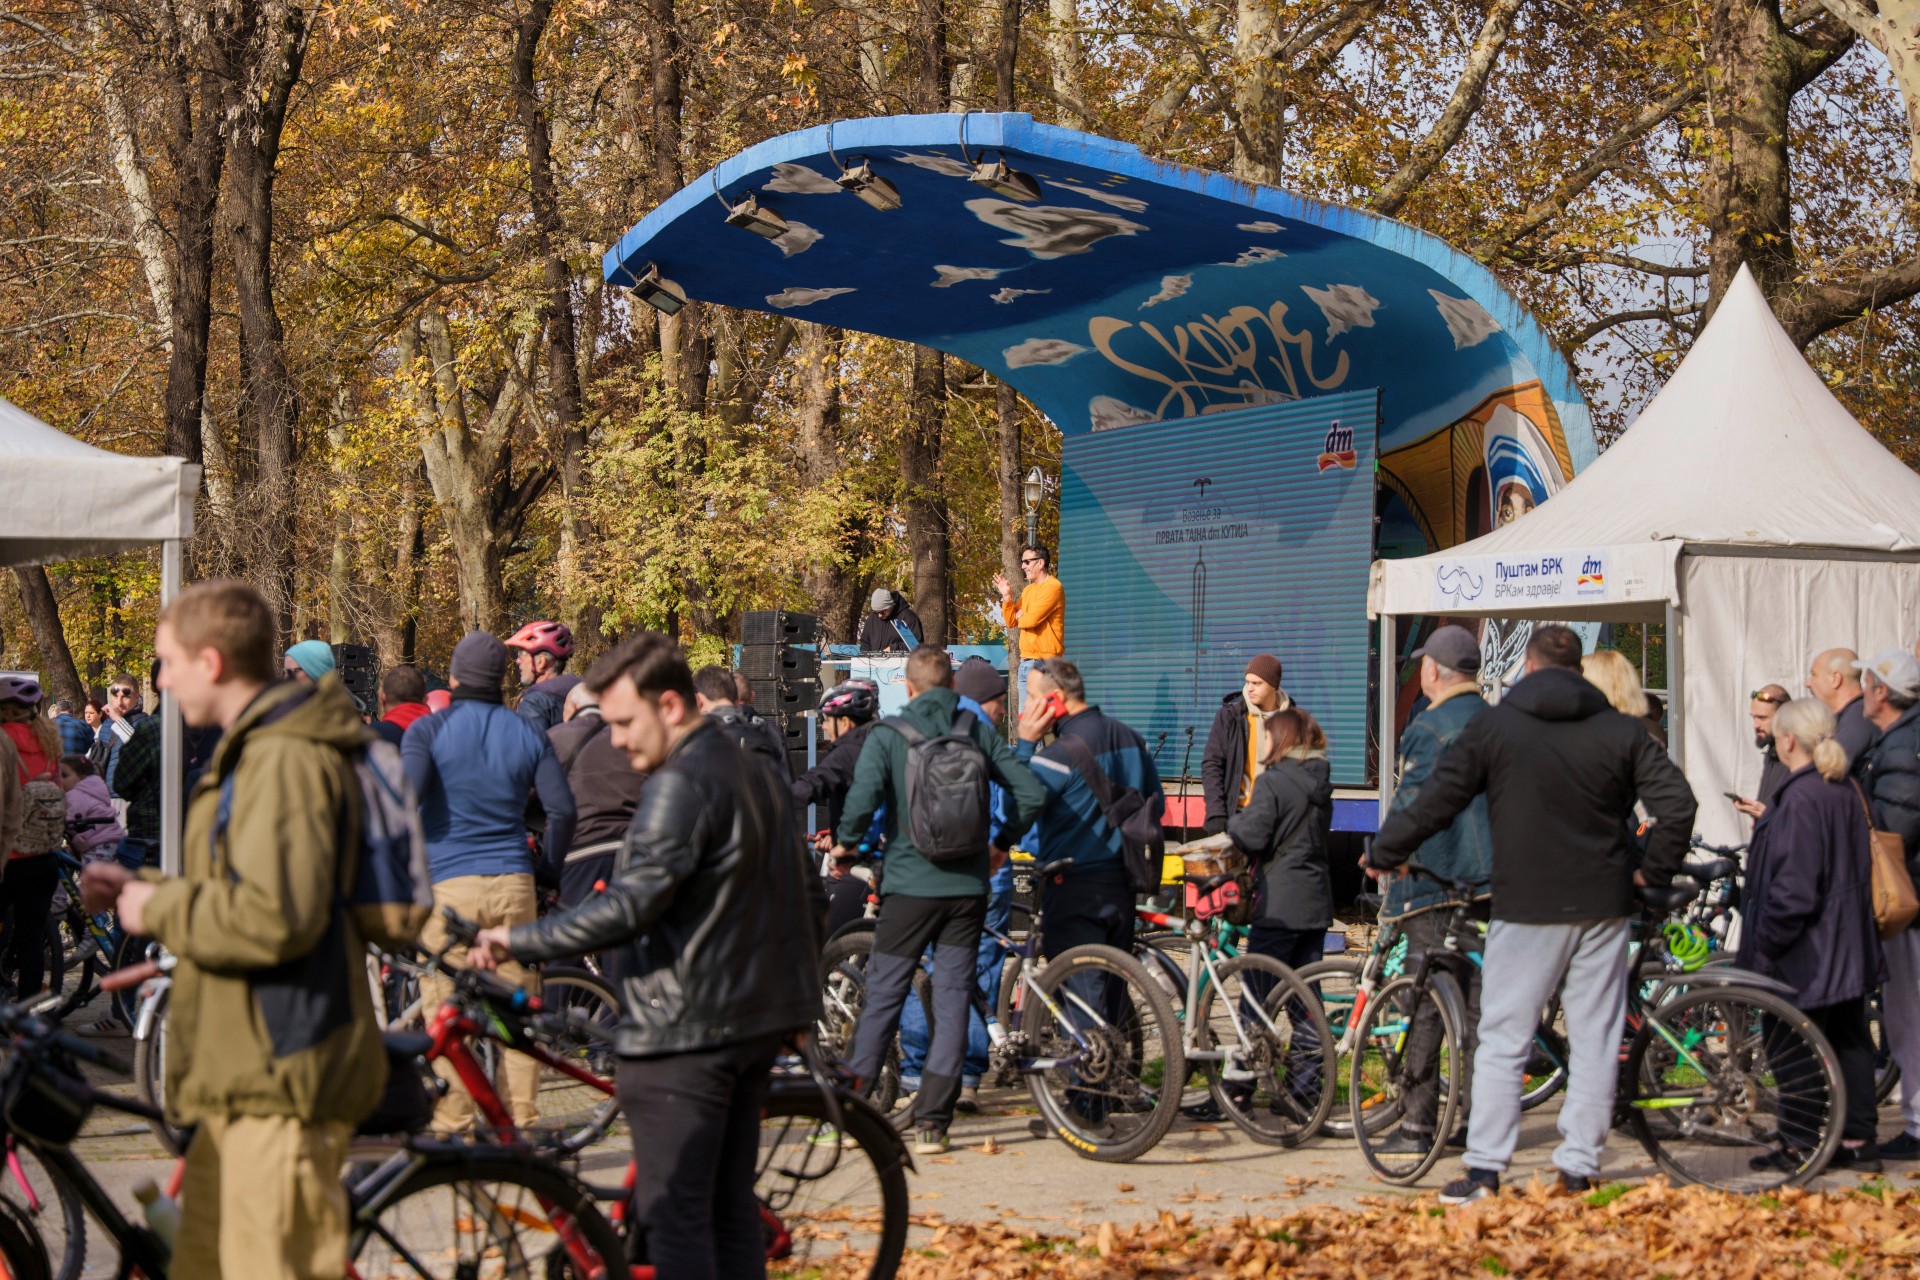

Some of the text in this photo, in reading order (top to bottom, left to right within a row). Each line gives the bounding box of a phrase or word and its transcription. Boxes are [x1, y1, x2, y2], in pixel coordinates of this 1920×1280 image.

[1325, 422, 1352, 453] dm
[1213, 508, 1222, 520] за
[1156, 523, 1249, 544] ПРВАТА ТАЈНА dm КУТИЈА
[1495, 557, 1563, 582] Пуштам БРК
[1582, 555, 1602, 574] dm
[1495, 581, 1562, 599] БРКам здравје!
